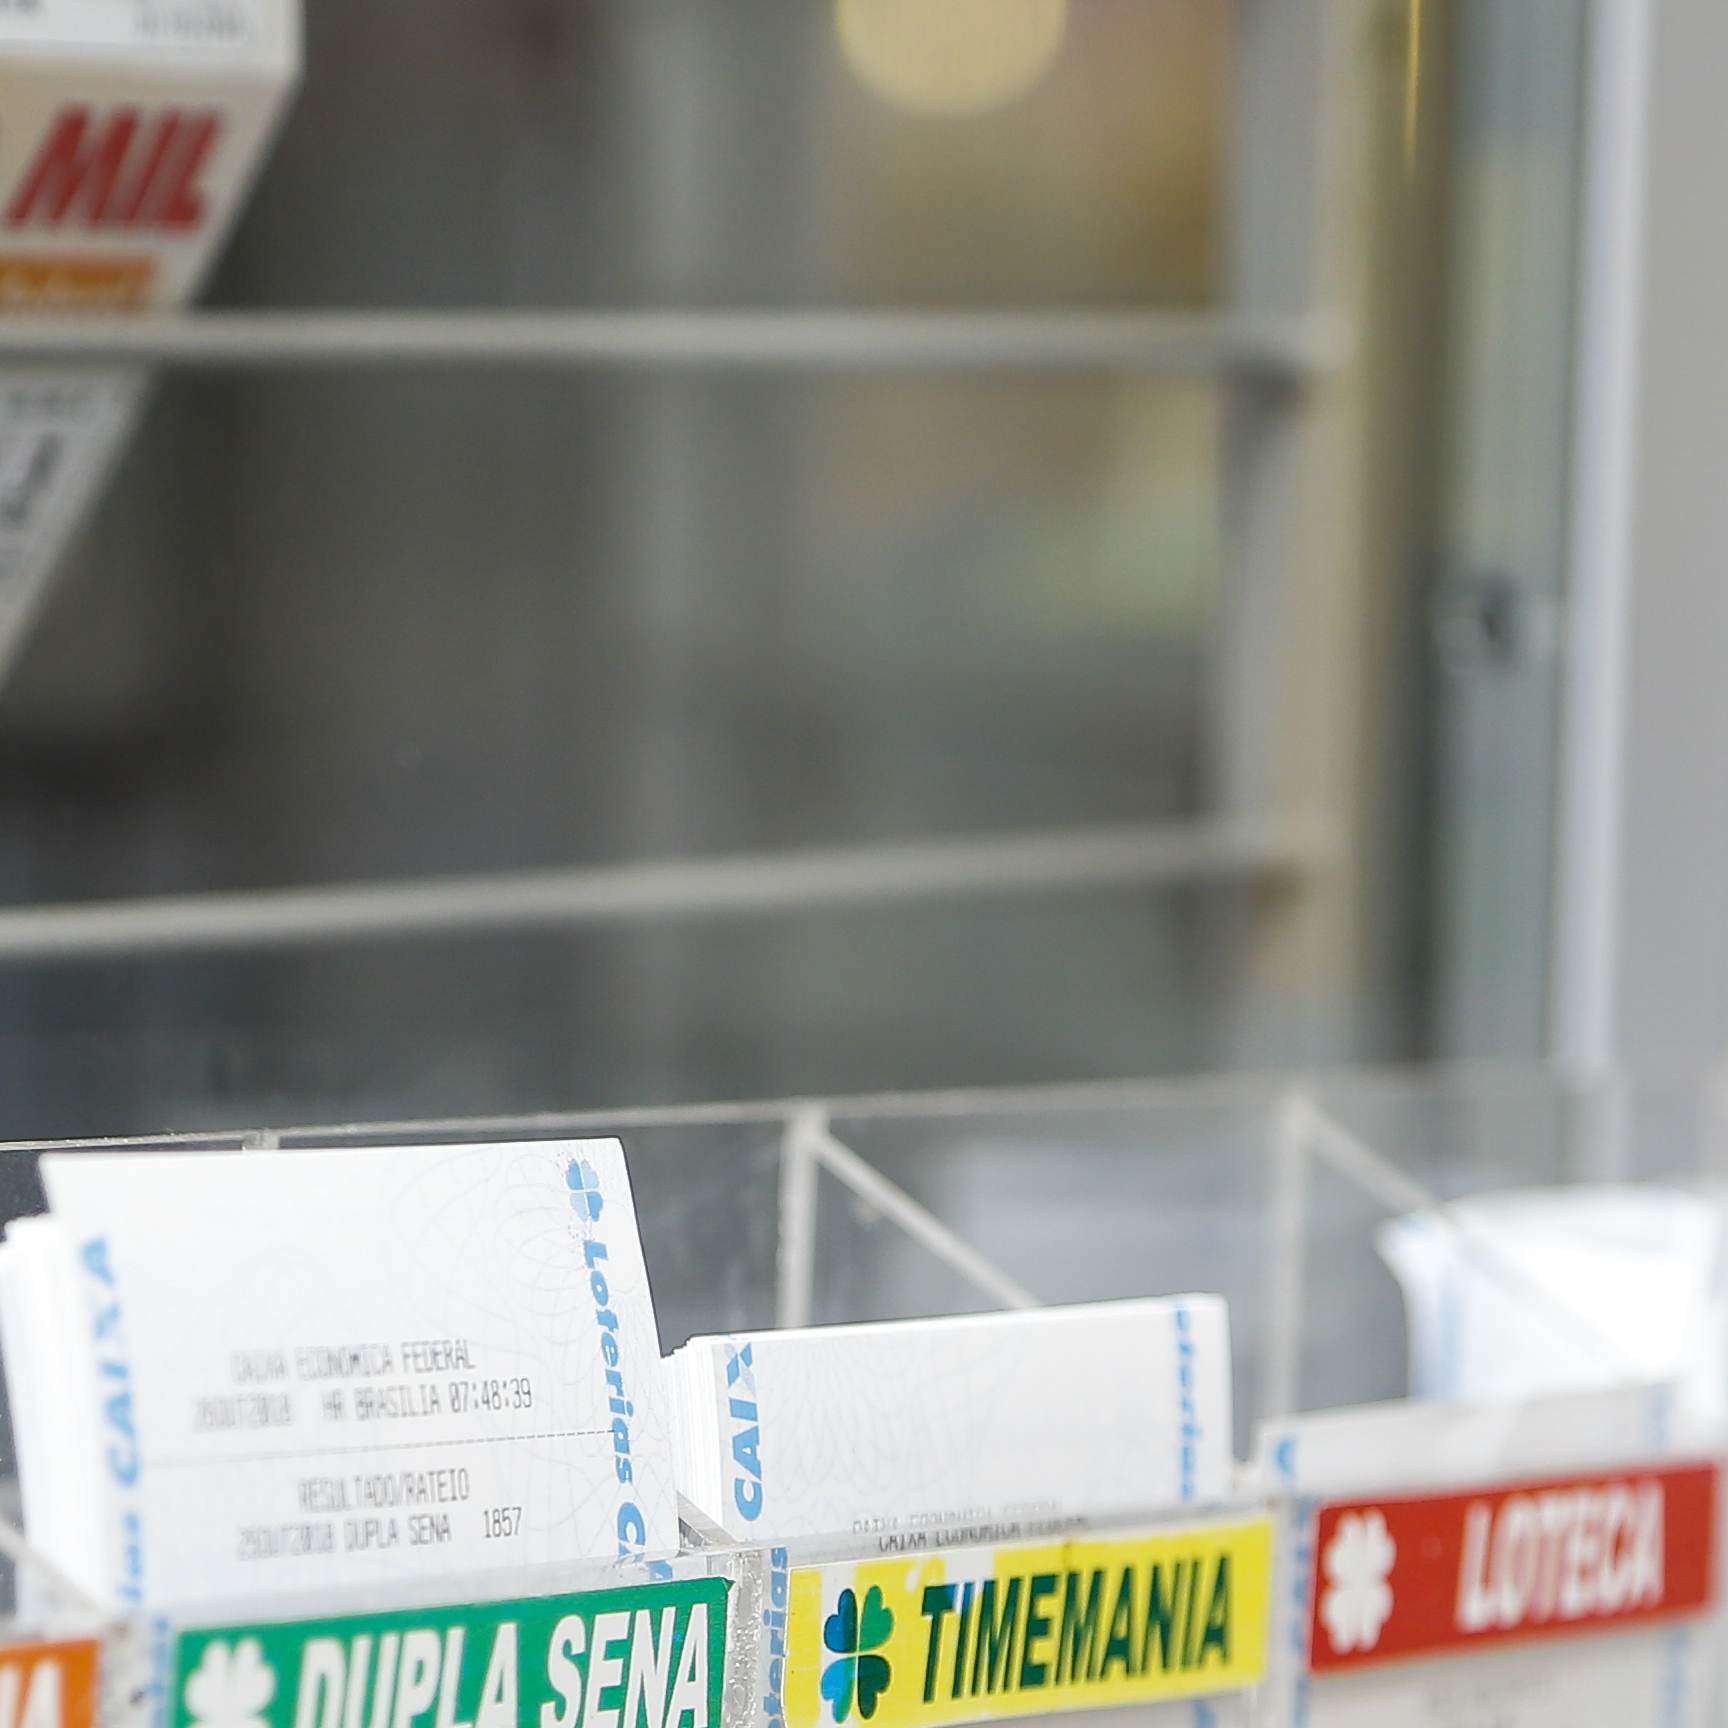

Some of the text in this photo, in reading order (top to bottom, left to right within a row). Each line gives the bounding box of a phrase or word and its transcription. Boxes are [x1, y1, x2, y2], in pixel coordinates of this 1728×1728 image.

[0, 106, 227, 236] MIL
[80, 1235, 143, 1488] CAIXA
[354, 1383, 442, 1422] BRASILIA
[447, 1377, 533, 1415] 07:48:39
[400, 1338, 477, 1374] FEDERAL
[582, 1238, 638, 1486] Loterias
[298, 1467, 470, 1514] RESULTADO/RATEIO
[729, 1338, 766, 1523] CAIX
[343, 1516, 400, 1553] DUPLA
[406, 1512, 453, 1548] SENA
[482, 1506, 523, 1540] 1857
[1454, 1479, 1666, 1635] LOTECA
[920, 1555, 1232, 1705] TIMEMANIA
